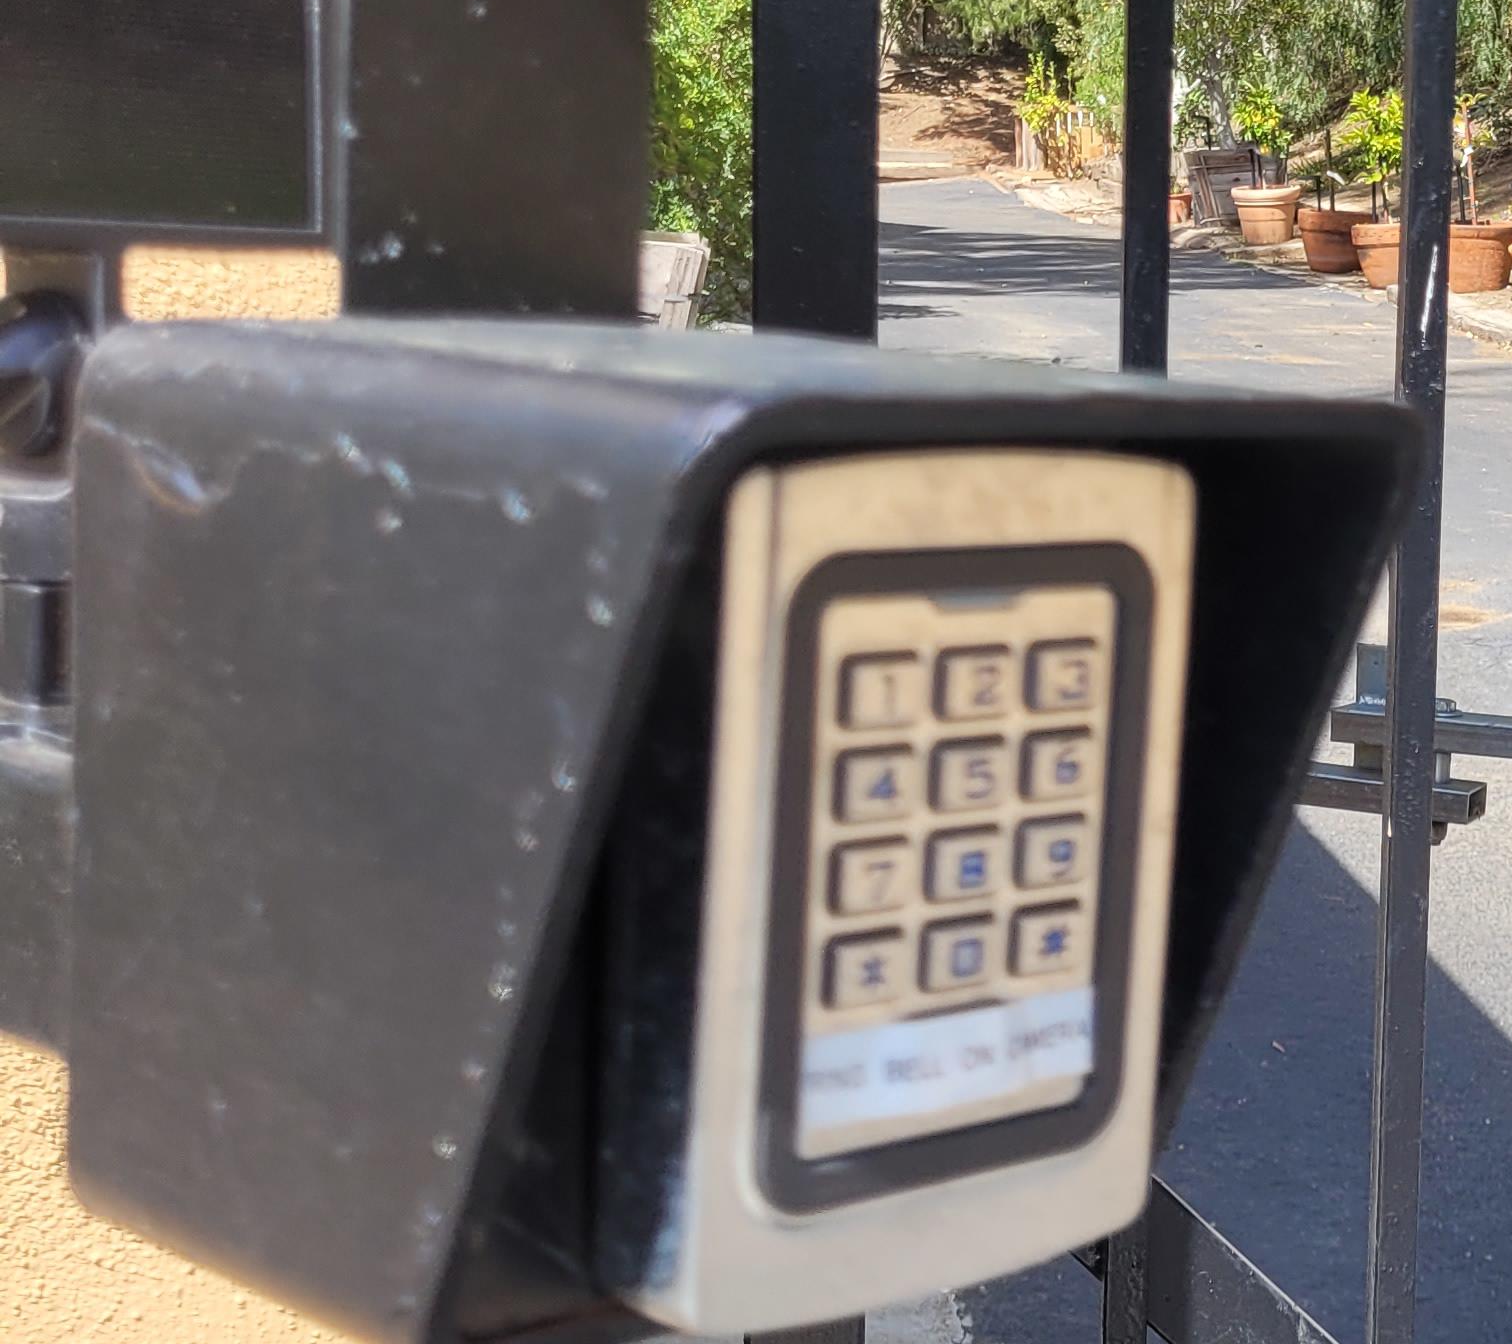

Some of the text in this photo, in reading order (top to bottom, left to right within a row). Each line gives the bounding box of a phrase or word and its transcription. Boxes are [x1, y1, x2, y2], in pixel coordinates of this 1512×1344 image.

[972, 663, 999, 706] 2
[1058, 657, 1090, 700] 3
[867, 744, 1081, 801] 4 5 6
[864, 838, 1076, 904] 7 8 9
[950, 936, 984, 979] 0
